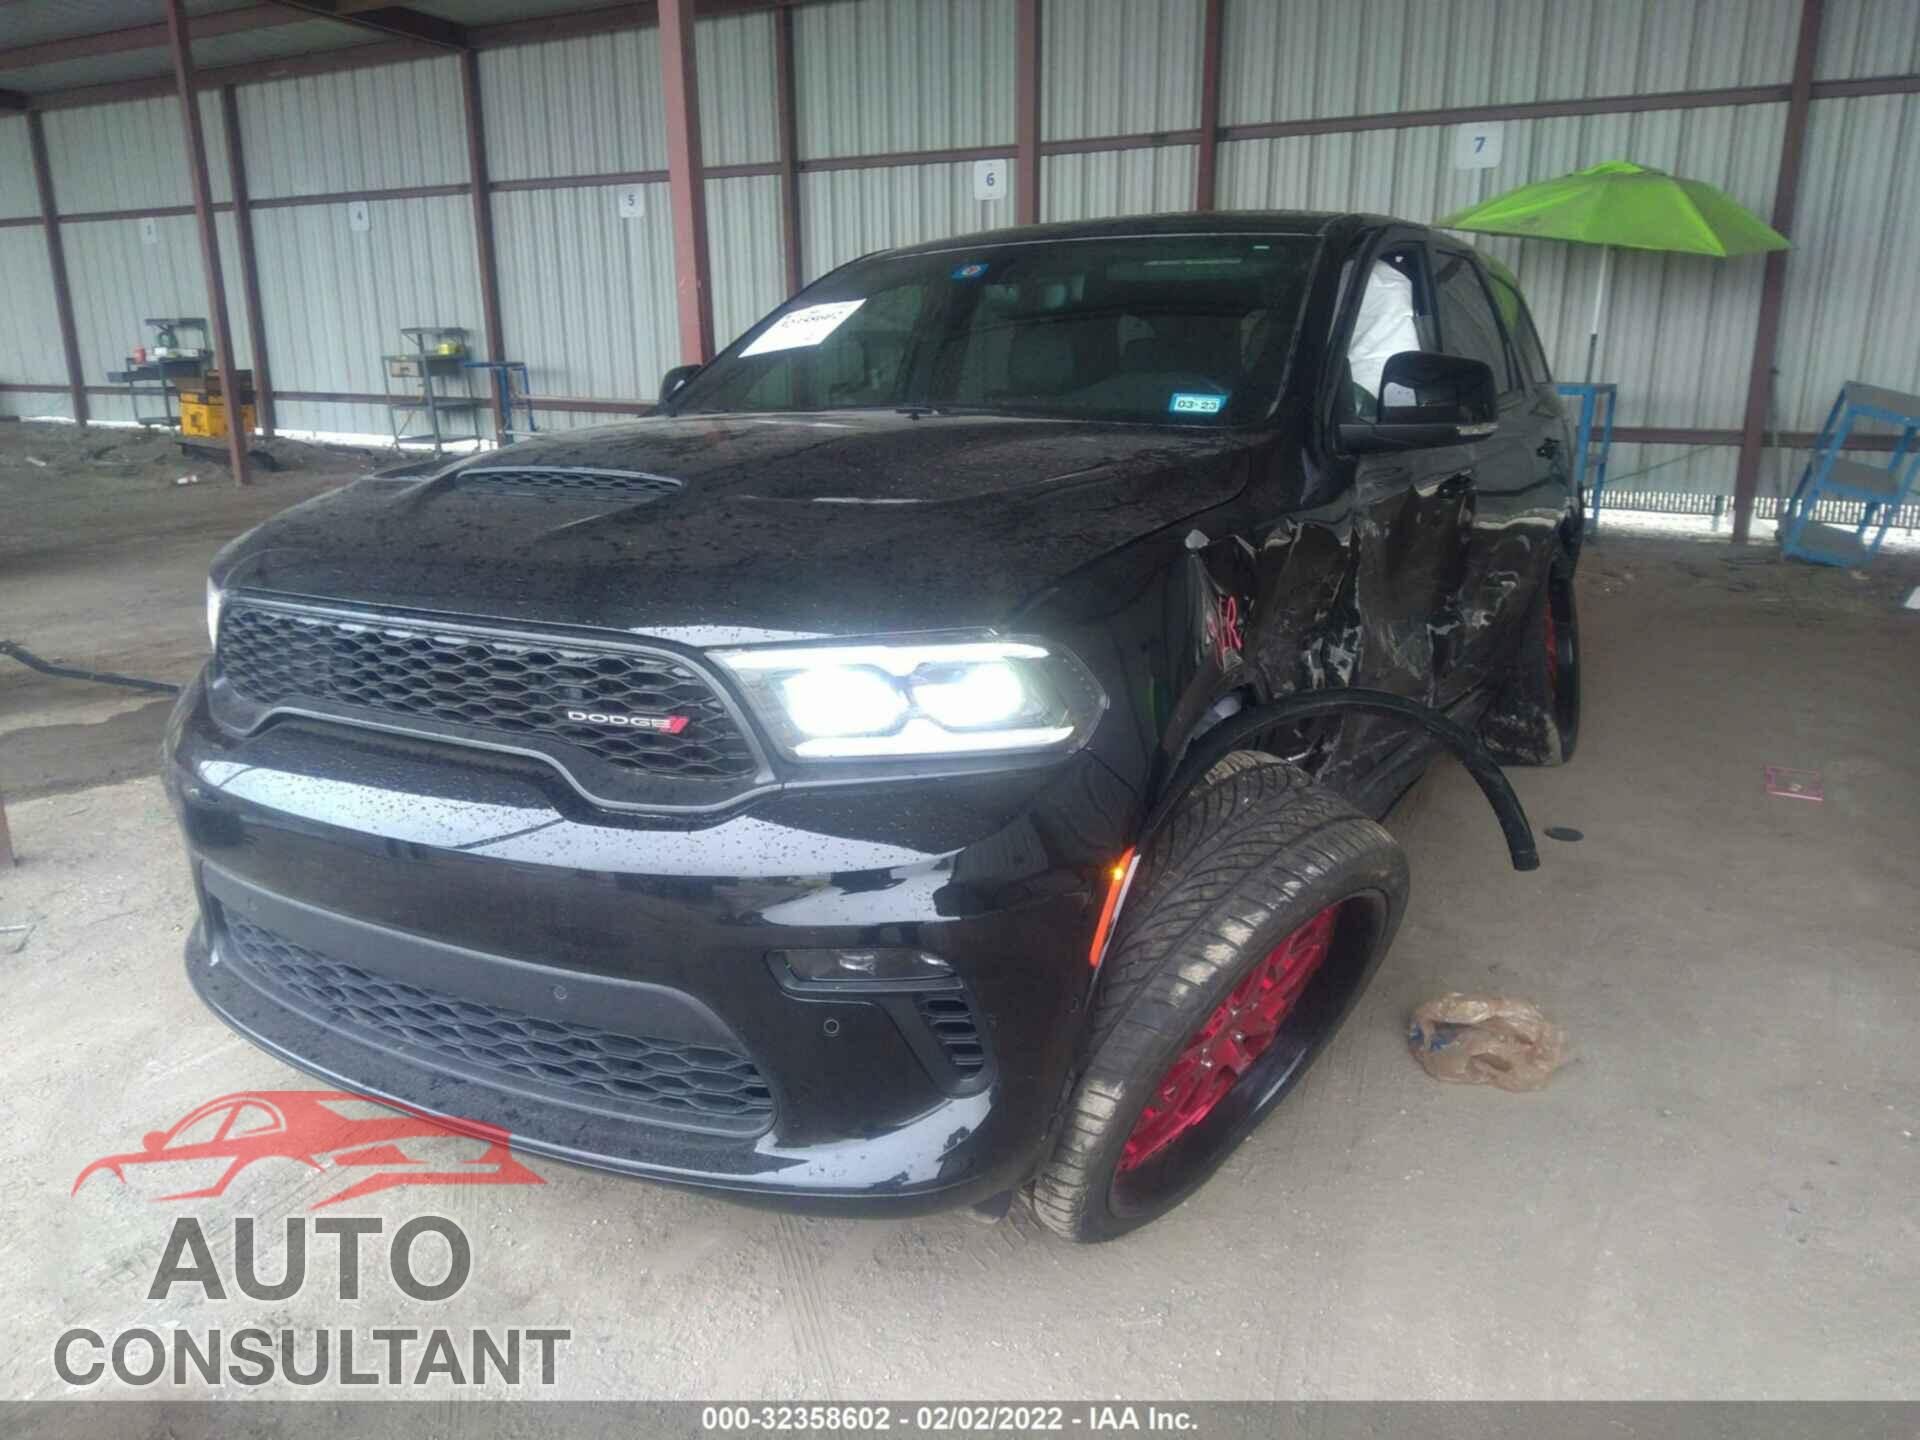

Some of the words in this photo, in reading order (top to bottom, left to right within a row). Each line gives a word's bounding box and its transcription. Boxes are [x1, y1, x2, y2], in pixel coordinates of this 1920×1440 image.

[1474, 136, 1486, 154] 7
[986, 172, 996, 187] 6
[627, 193, 636, 207] 5
[567, 711, 672, 729] DODGE
